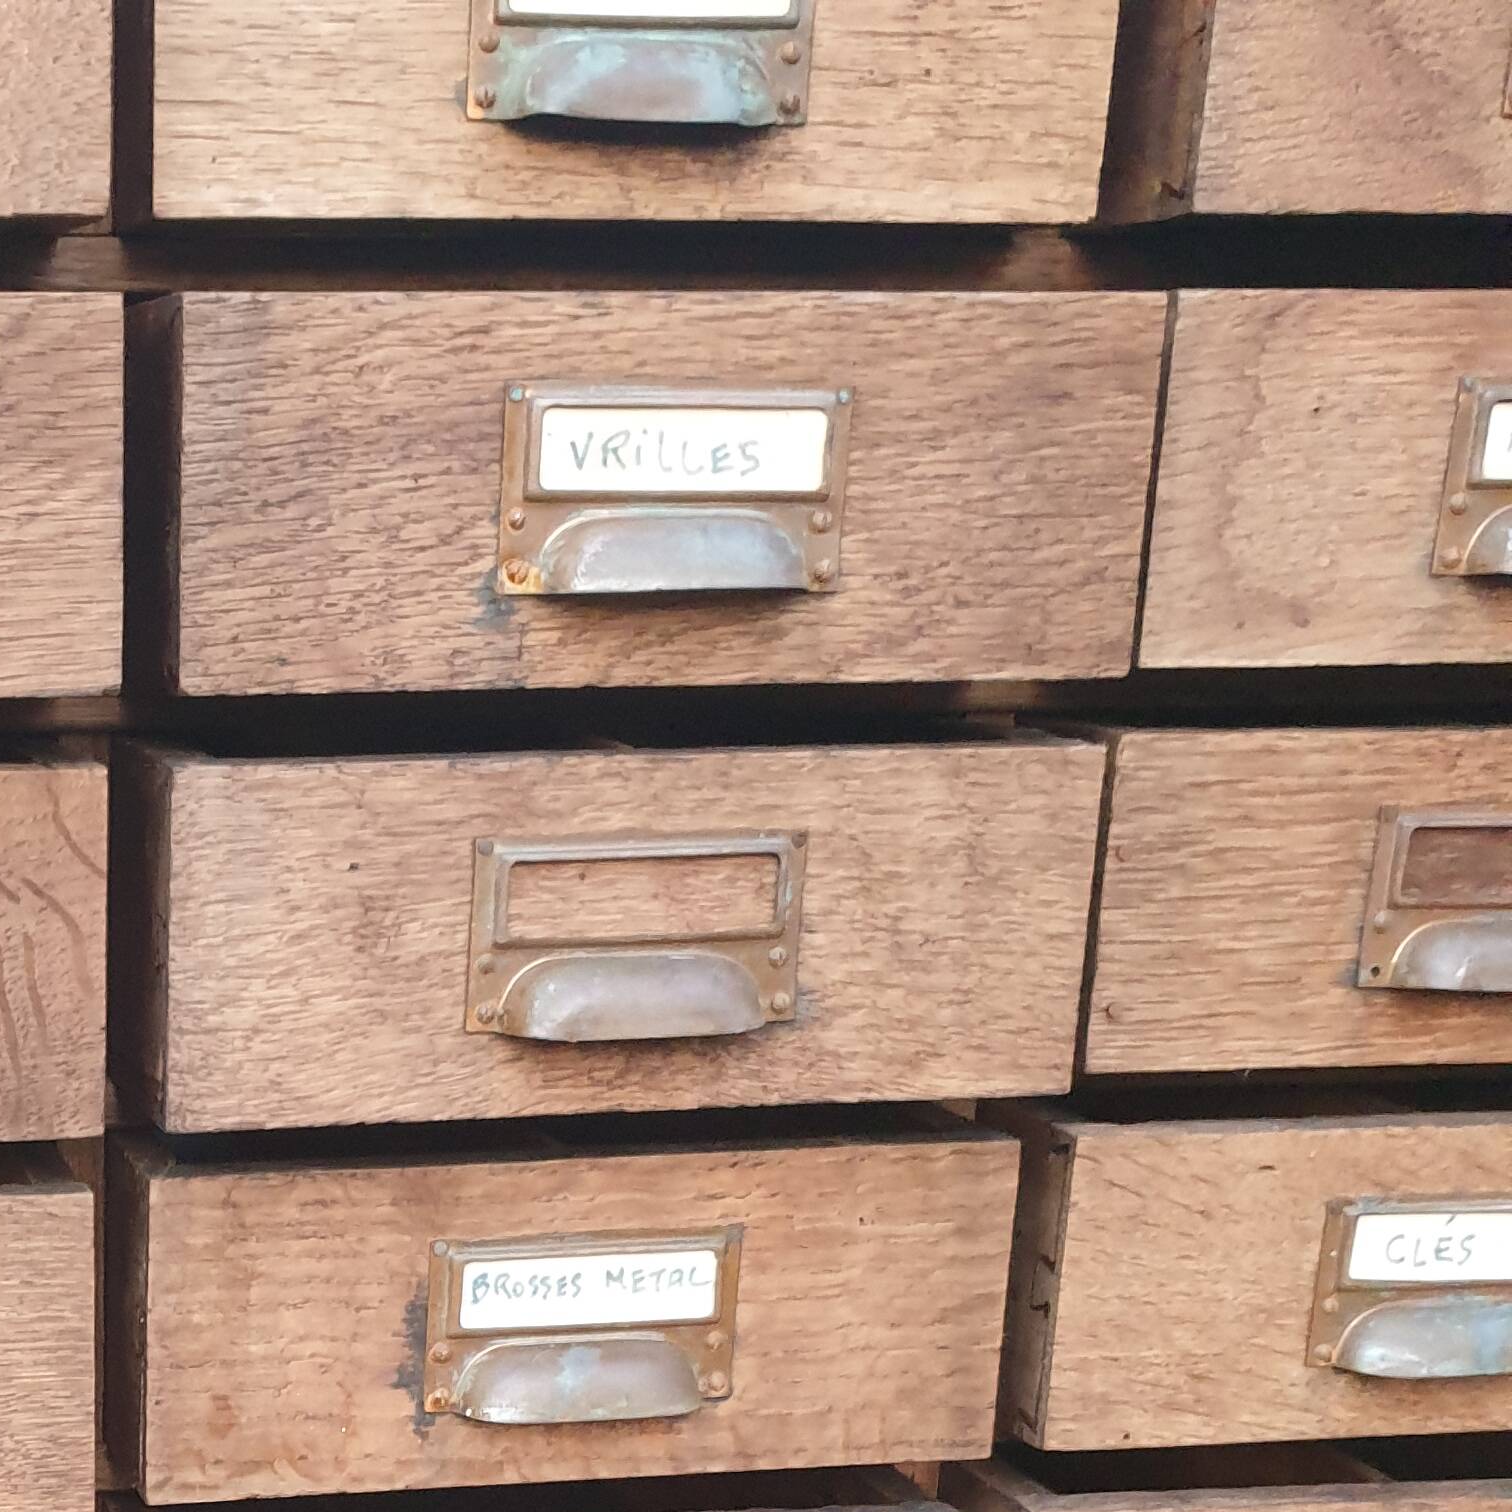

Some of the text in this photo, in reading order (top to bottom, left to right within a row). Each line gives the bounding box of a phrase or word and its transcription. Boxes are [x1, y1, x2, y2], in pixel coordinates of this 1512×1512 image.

[1385, 1214, 1476, 1267] CLÉS
[472, 1266, 712, 1304] BROSSES METAL
